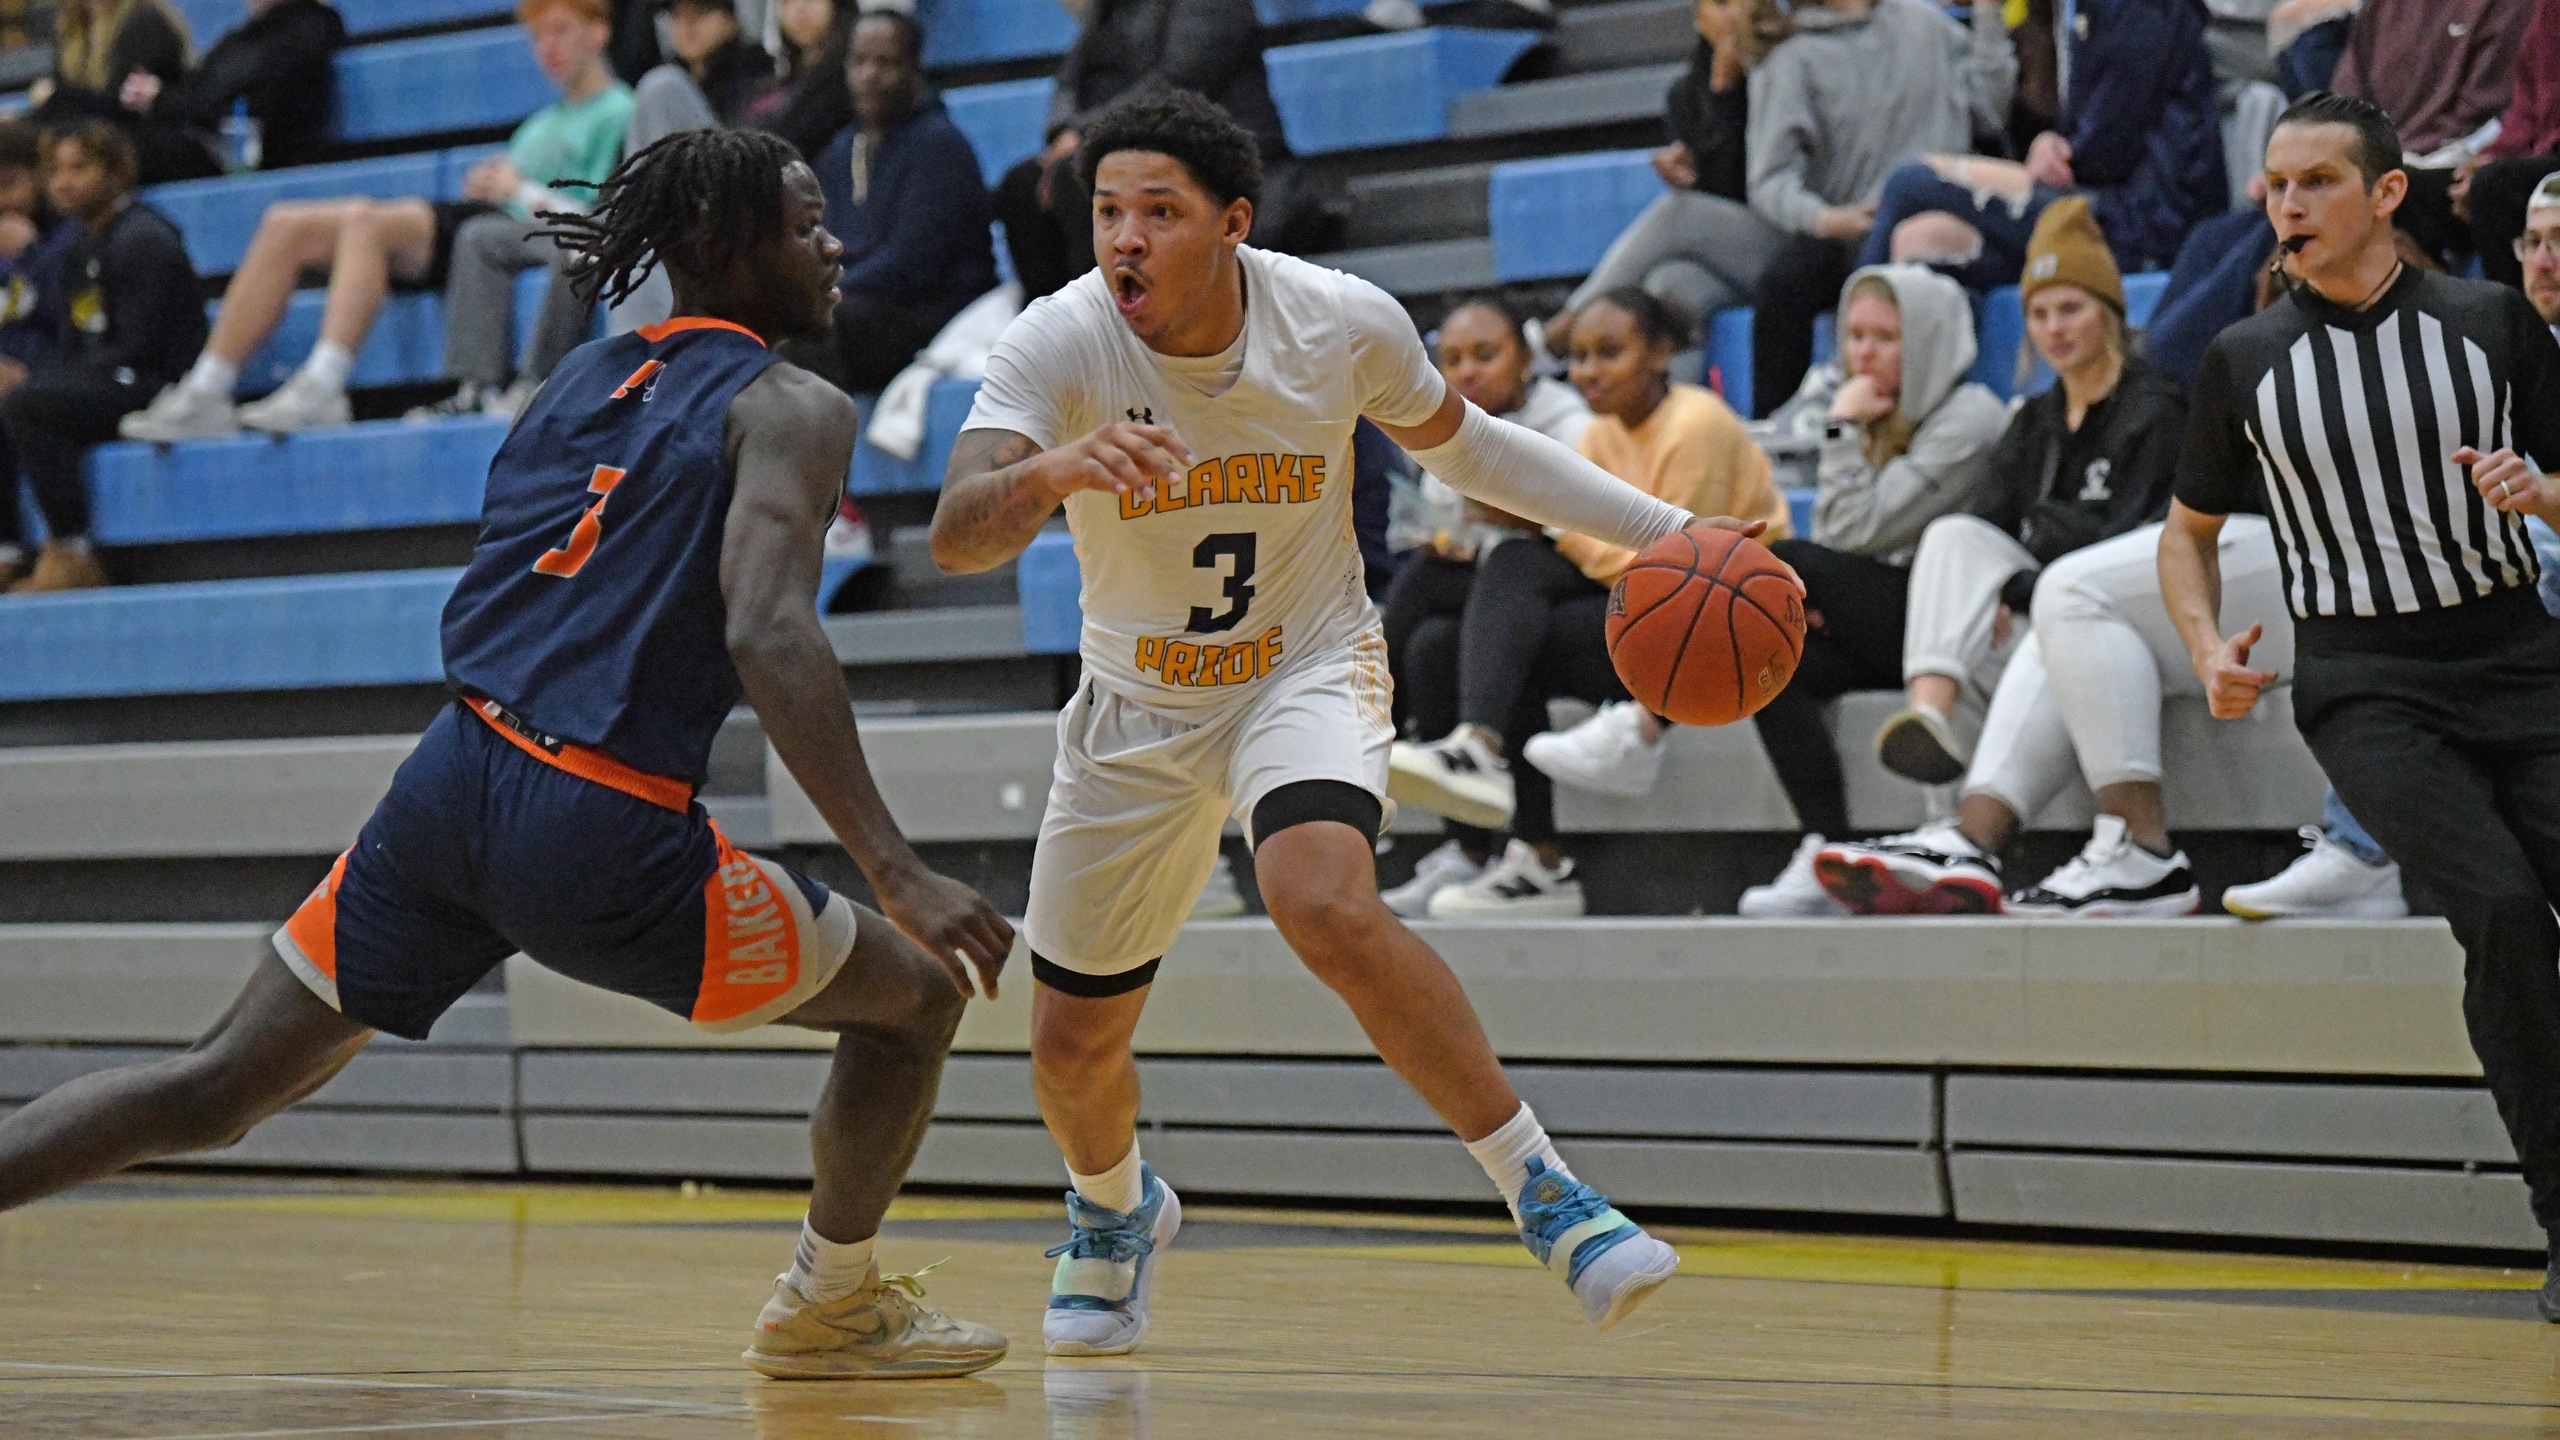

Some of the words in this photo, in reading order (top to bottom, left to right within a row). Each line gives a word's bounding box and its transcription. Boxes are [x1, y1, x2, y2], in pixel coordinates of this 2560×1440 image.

[531, 464, 627, 578] 3
[1119, 452, 1326, 521] CLARKE
[1184, 531, 1257, 634] 3
[1135, 624, 1283, 687] PRIDE
